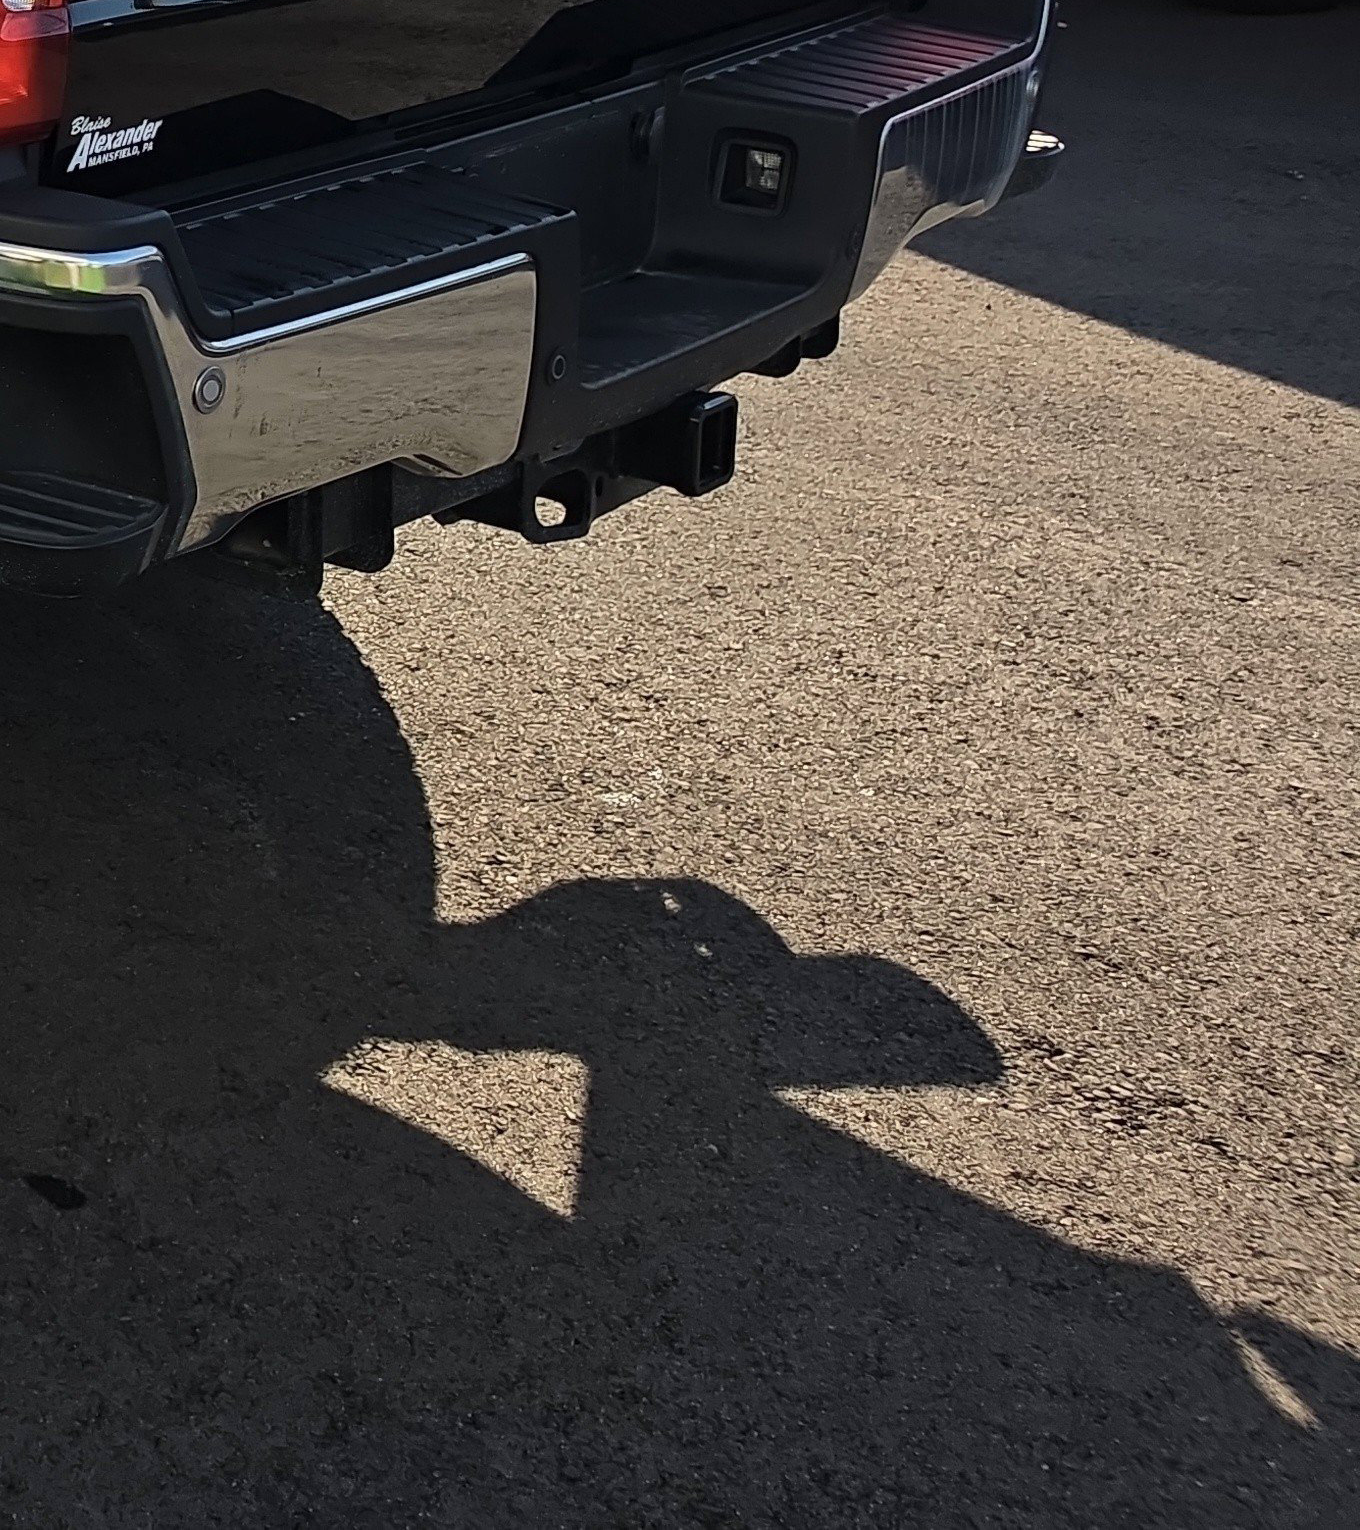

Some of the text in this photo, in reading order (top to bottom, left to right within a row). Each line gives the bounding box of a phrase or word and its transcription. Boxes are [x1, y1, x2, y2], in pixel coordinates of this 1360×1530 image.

[70, 115, 112, 135] Blaise
[67, 119, 163, 172] Alexander
[88, 141, 154, 167] MANSFIELD, PA
